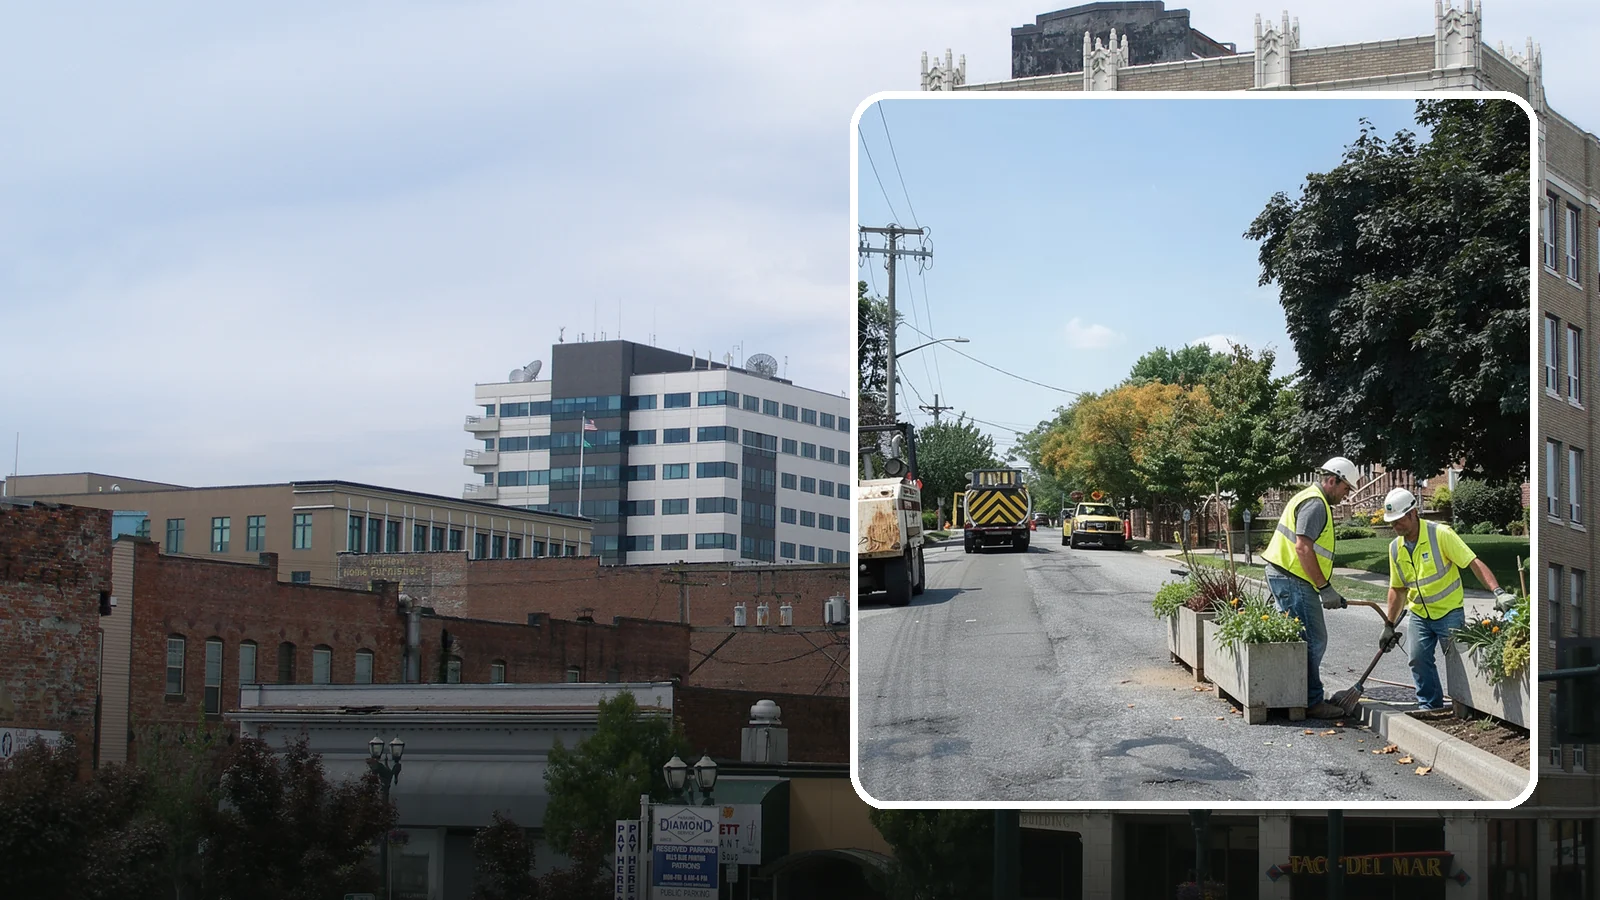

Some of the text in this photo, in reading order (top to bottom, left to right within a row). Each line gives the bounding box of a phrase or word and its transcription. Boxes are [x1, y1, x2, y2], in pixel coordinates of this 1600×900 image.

[343, 566, 427, 577] Home Furnishers
[660, 818, 713, 833] DIAMOND
[1022, 815, 1070, 828] BUILDING
[617, 825, 625, 852] PAY
[628, 824, 637, 852] PAY
[656, 845, 687, 853] RESERVED
[722, 852, 739, 861] Soup
[671, 862, 701, 870] PATRONS
[1346, 856, 1384, 876] DEL
[1392, 857, 1442, 877] MAR
[616, 856, 625, 894] HERE
[628, 855, 637, 893] HERE
[660, 889, 710, 898] PUBLIC PARKING
